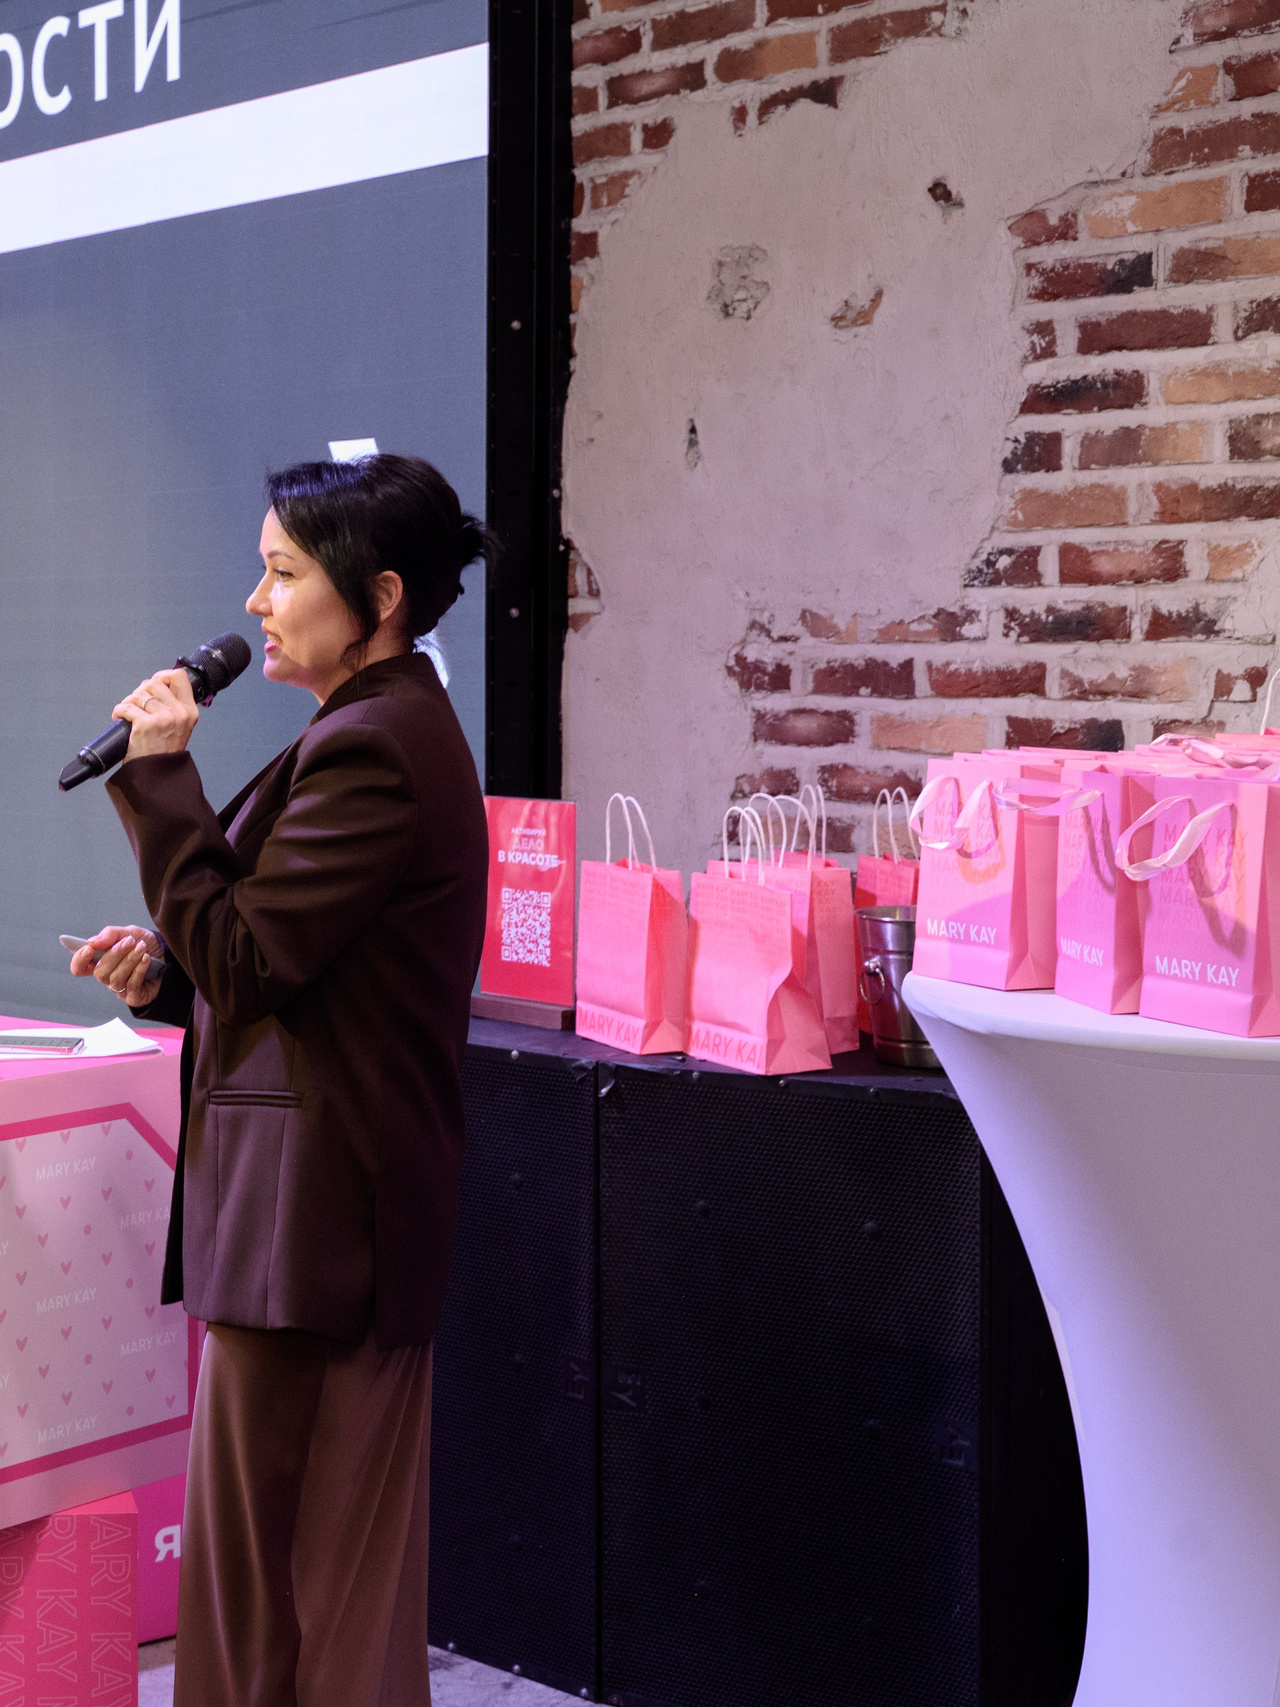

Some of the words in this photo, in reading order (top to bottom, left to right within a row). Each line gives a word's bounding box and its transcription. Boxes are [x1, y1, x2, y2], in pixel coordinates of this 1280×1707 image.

[498, 849, 506, 863] В
[507, 851, 559, 867] КРАСОТЕ
[512, 837, 545, 851] ДЕЛО
[926, 918, 966, 940] MARY
[970, 924, 997, 945] KAY
[1060, 936, 1082, 961] MARY
[1083, 945, 1104, 967] KAY
[1155, 955, 1202, 981] MARY
[1207, 963, 1239, 988] KAY
[577, 1006, 614, 1037] MARY
[616, 1021, 640, 1048] KAY
[691, 1028, 734, 1058] MARY
[35, 1160, 71, 1181] MARY
[74, 1156, 96, 1174] KAY
[119, 1209, 153, 1230] MARY
[155, 1205, 170, 1221] KA
[36, 1293, 72, 1314] MARY
[74, 1286, 97, 1305] KAY
[120, 1335, 153, 1358] MARY
[156, 1329, 178, 1348] KAY
[37, 1421, 72, 1444] MARY
[75, 1414, 98, 1433] KAY
[154, 1523, 181, 1563] Я
[36, 1588, 78, 1684] KAY
